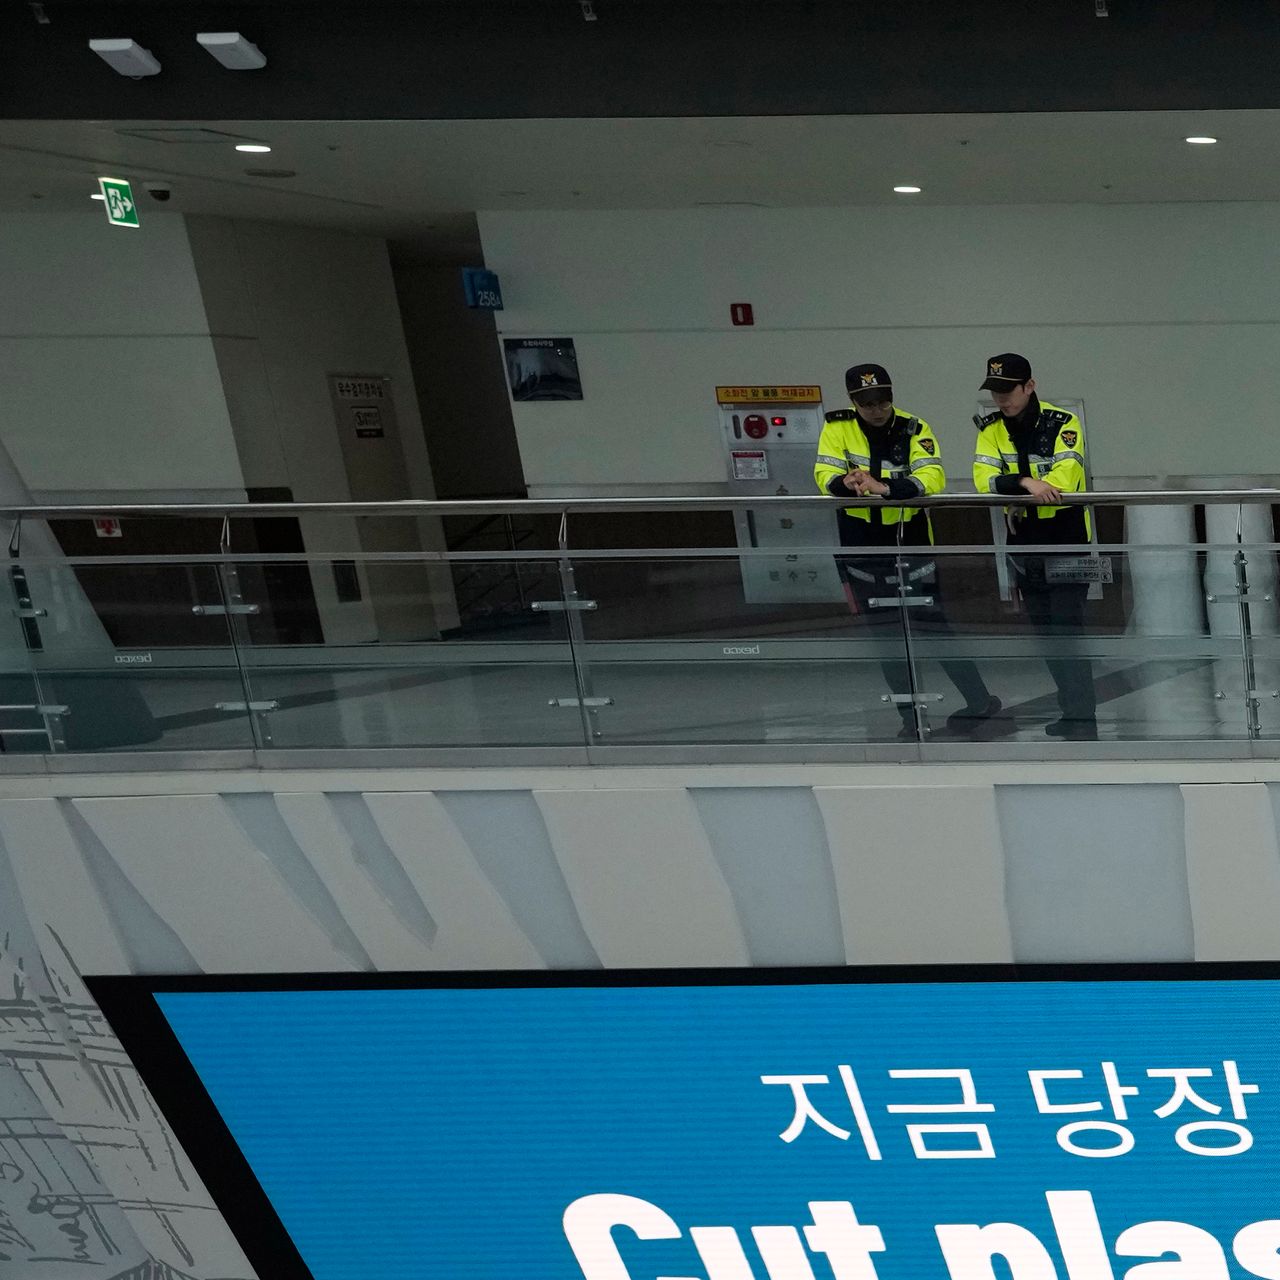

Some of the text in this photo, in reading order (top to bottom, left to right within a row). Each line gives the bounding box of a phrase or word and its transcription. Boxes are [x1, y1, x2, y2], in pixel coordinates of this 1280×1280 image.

[723, 388, 749, 398] 소화전
[762, 1065, 996, 1160] 지금
[1029, 1060, 1259, 1157] 당장
